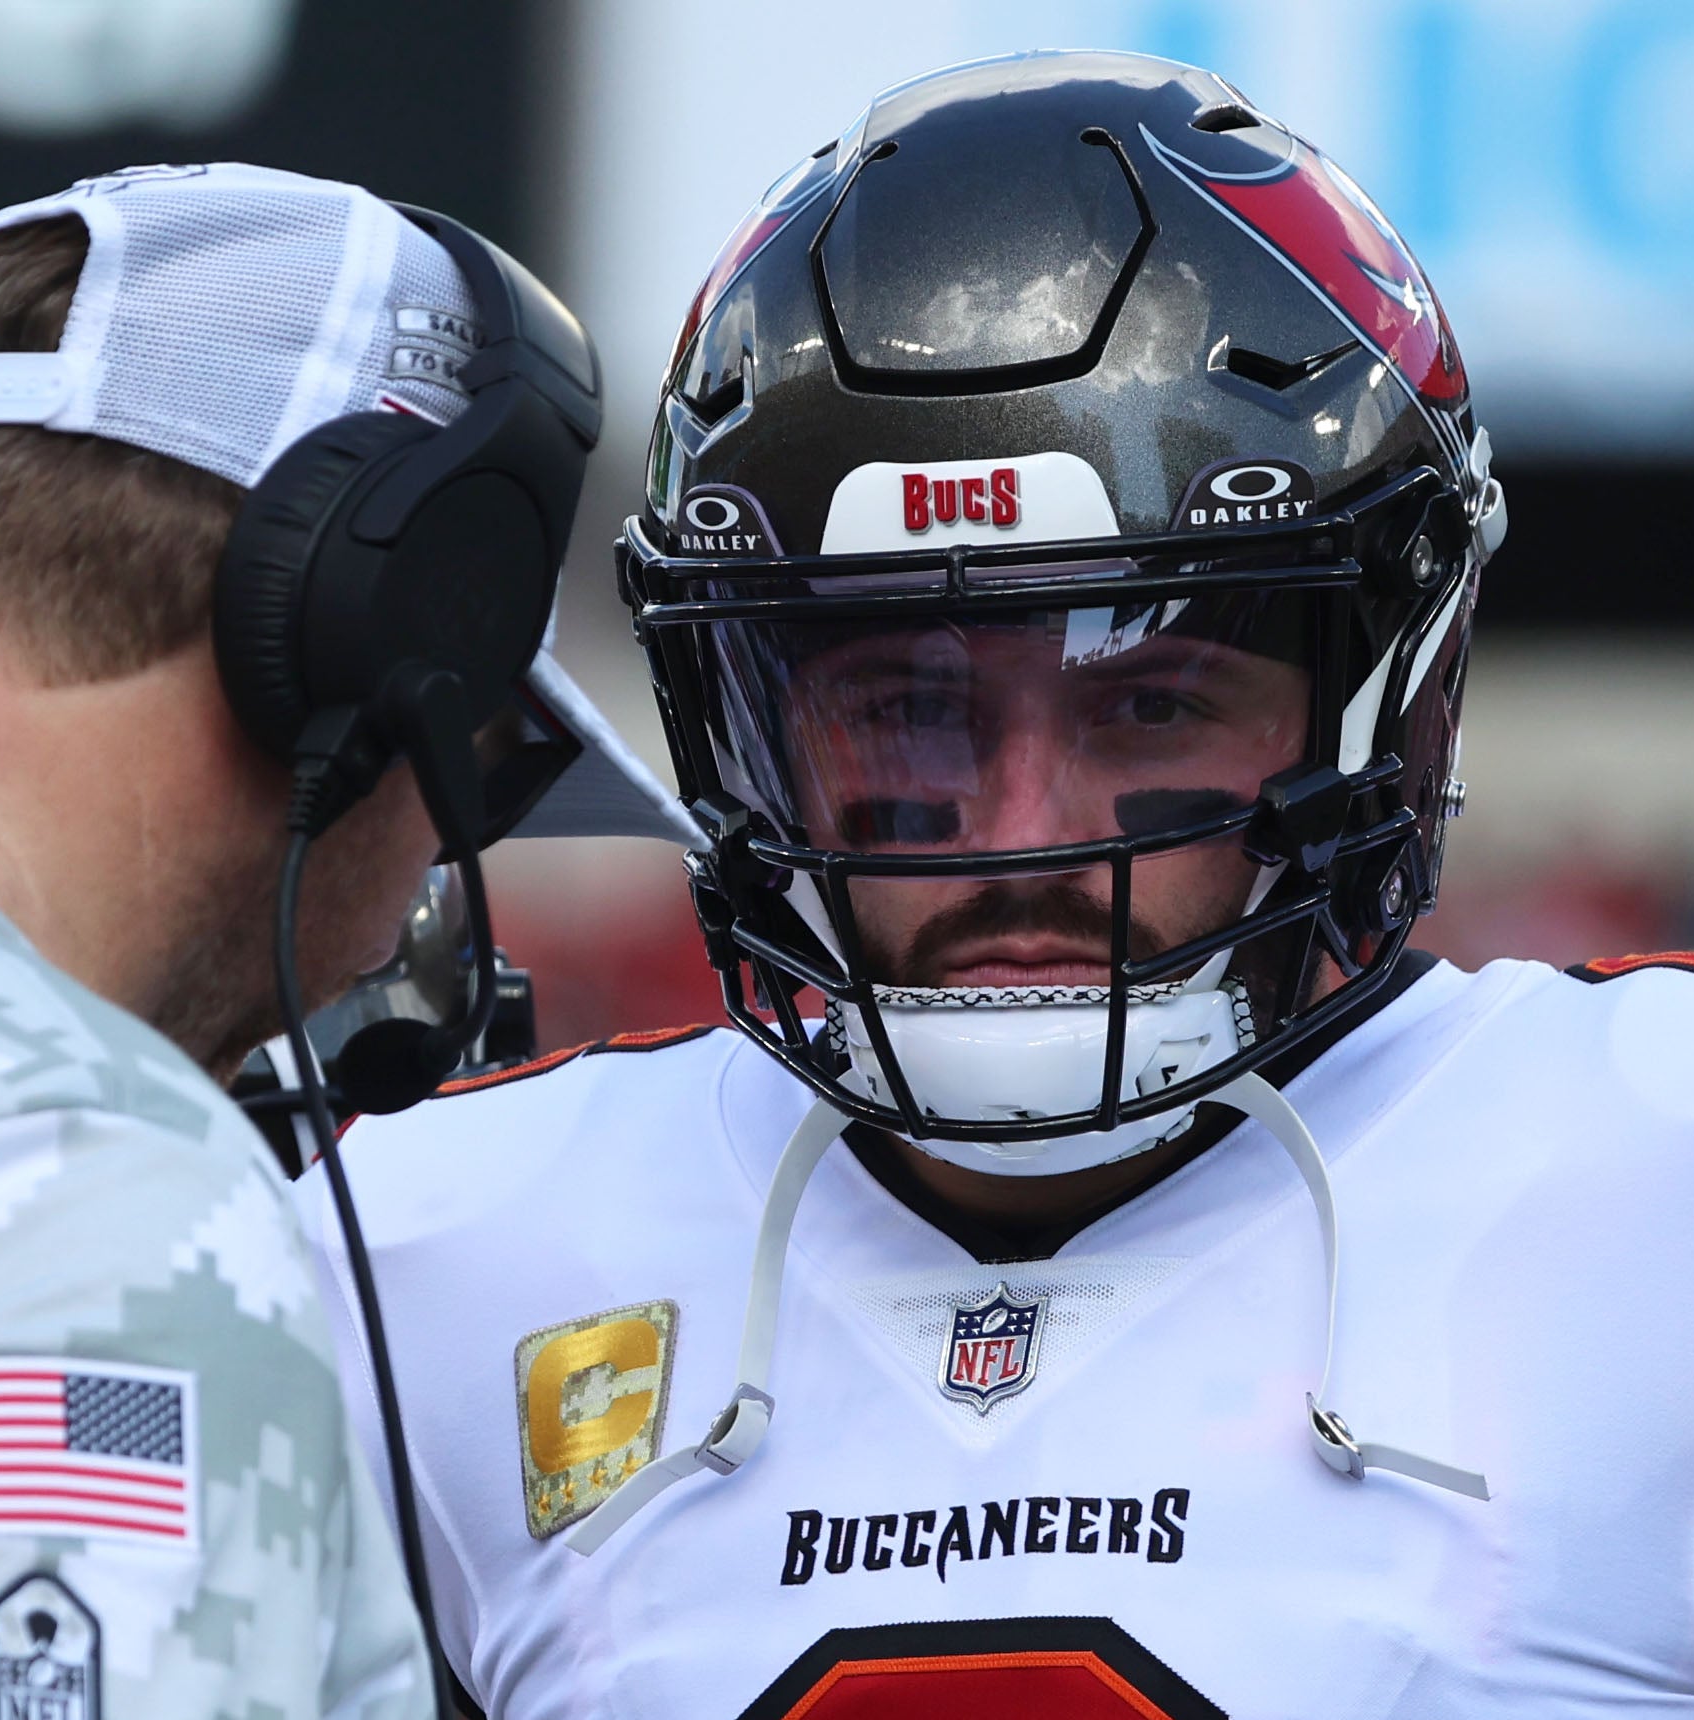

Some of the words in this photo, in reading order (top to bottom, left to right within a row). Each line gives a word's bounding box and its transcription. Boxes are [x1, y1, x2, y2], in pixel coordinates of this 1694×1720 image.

[410, 351, 436, 371] TO
[901, 468, 1022, 535] BUCS
[1190, 499, 1308, 526] OAKLEY
[680, 533, 757, 551] OAKLEY
[952, 1338, 1020, 1387] NFL
[527, 1318, 660, 1476] C
[779, 1487, 1191, 1586] BUCCANEERS
